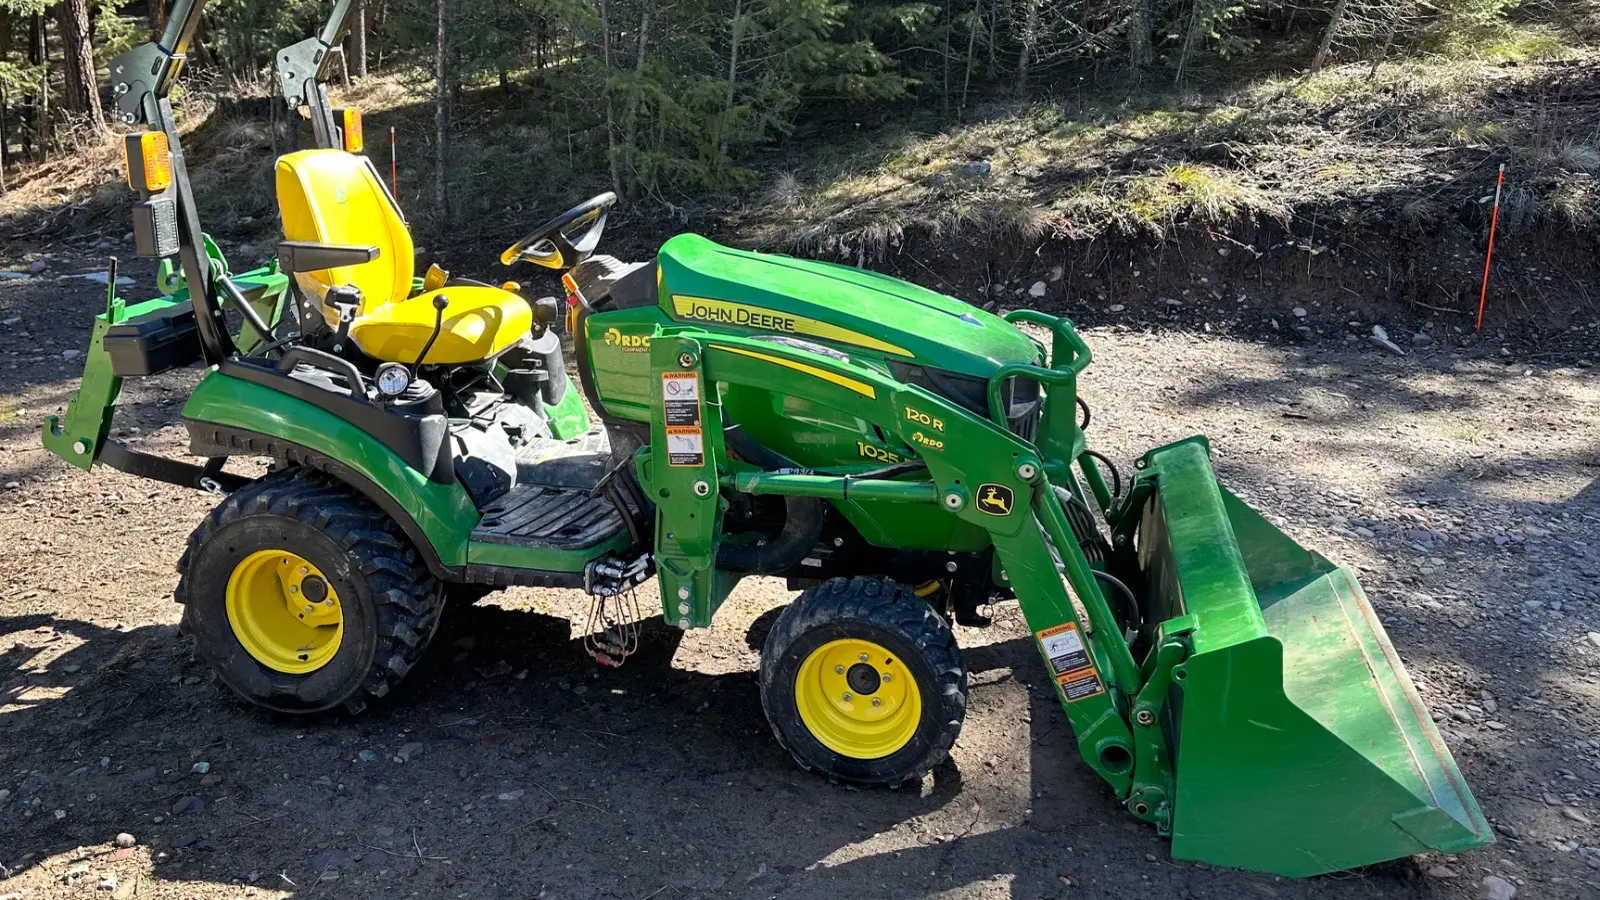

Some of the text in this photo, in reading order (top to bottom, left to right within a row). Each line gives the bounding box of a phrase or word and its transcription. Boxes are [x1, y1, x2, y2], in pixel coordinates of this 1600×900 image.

[686, 303, 795, 331] JOHN DEERE
[905, 406, 944, 431] 120 R
[923, 437, 944, 448] RDO
[857, 440, 899, 464] 1025
[1048, 624, 1072, 635] WARNING
[1069, 671, 1092, 680] WARNING
